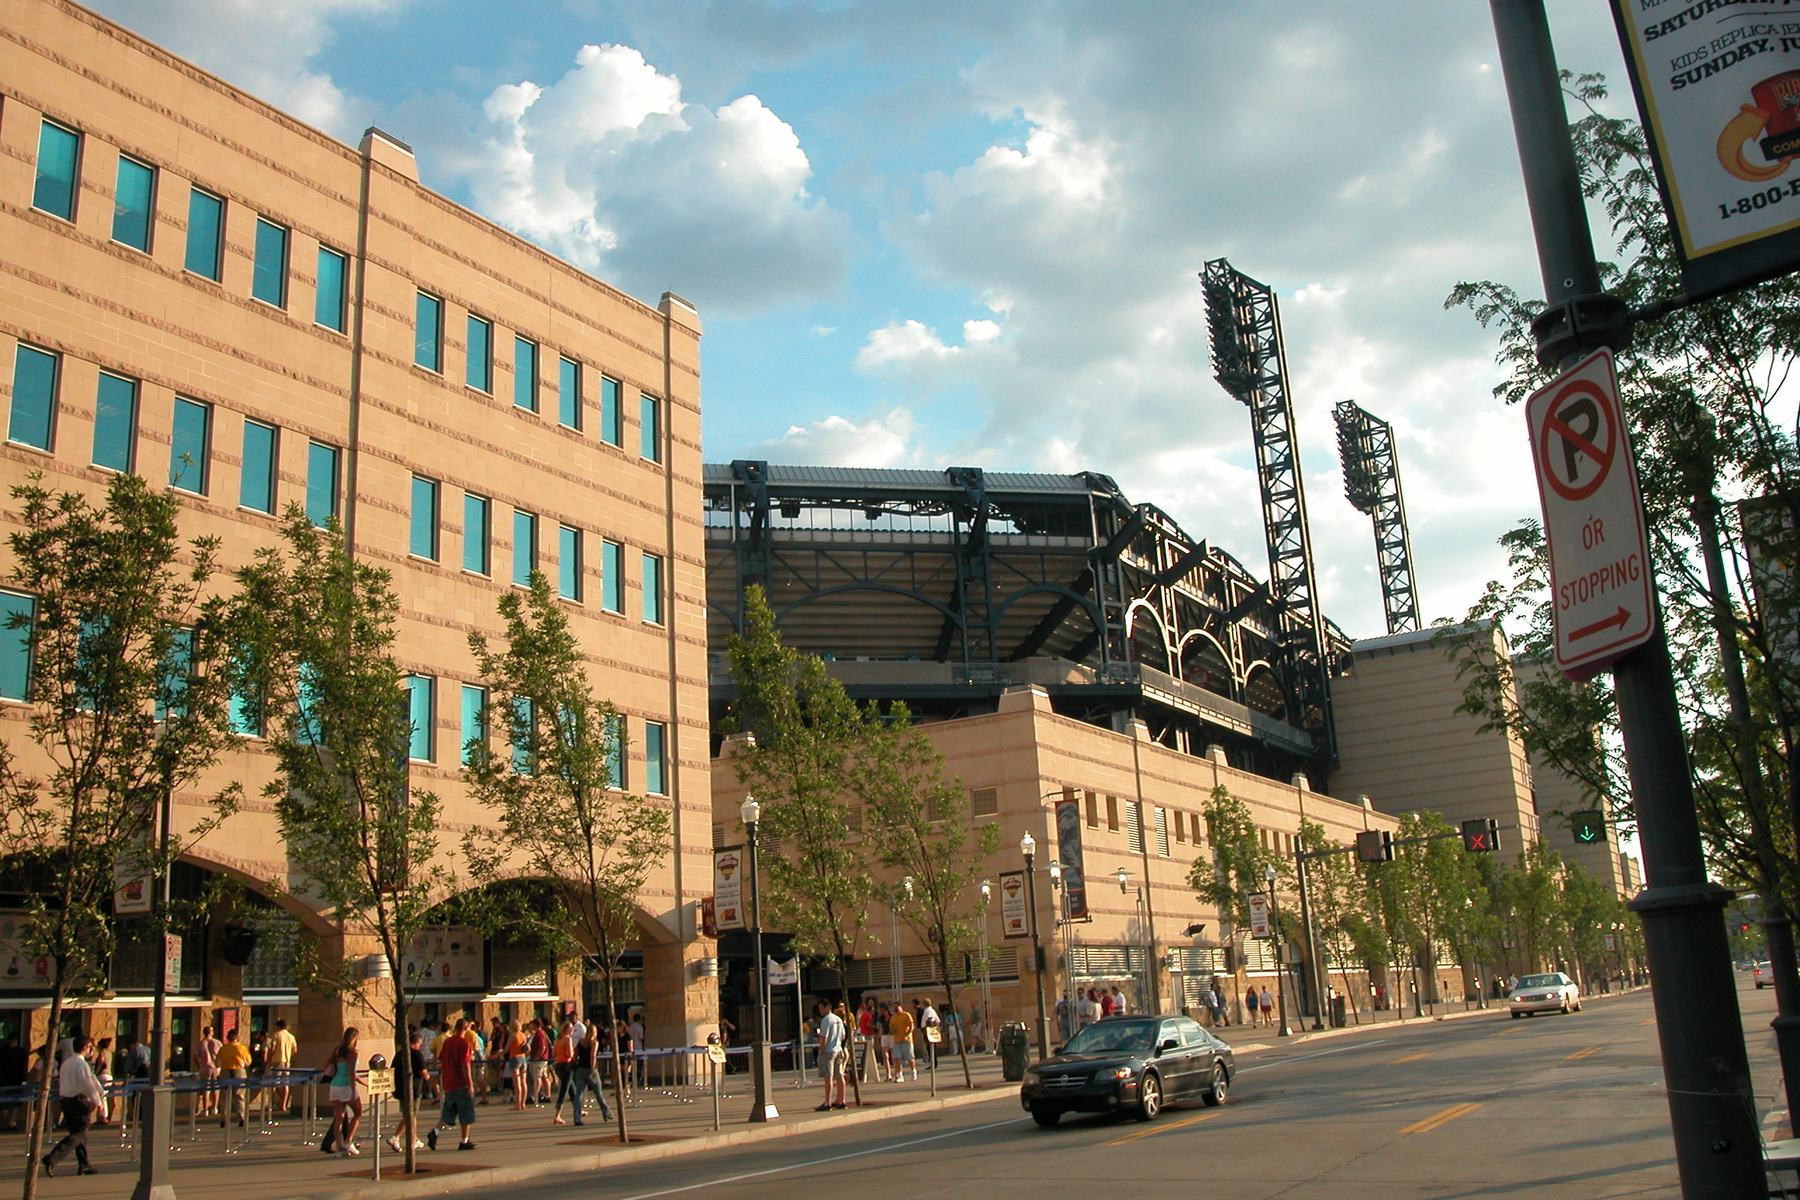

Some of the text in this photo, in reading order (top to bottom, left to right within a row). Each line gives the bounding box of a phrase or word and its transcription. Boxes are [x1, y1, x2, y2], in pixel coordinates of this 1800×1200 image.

[1670, 46, 1709, 72] KIDS
[1710, 24, 1778, 54] REPLICA
[1582, 518, 1605, 549] OR
[1560, 553, 1639, 611] STOPPING
